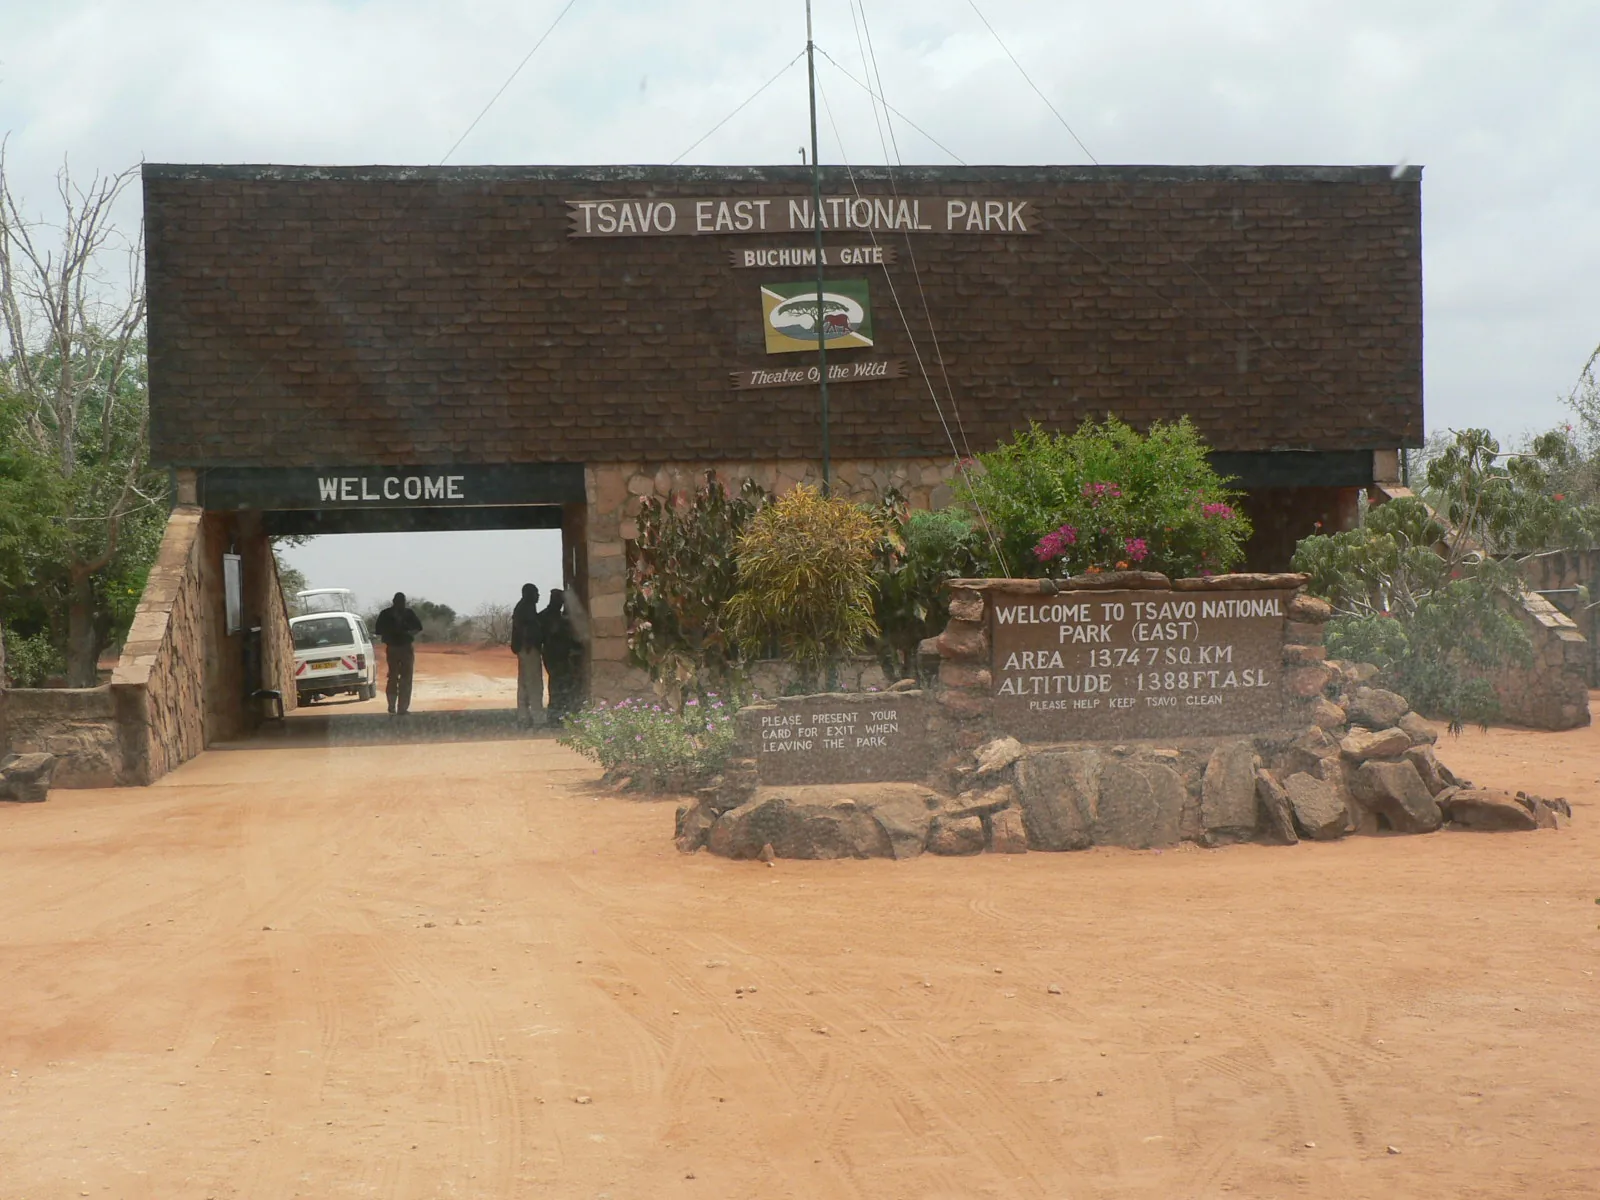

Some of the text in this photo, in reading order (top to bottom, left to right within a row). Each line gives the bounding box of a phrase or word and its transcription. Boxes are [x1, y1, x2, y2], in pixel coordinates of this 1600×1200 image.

[579, 198, 1028, 234] TSAVO EAST NATIONAL PARK
[744, 247, 883, 268] BUCHUMA GATE
[750, 369, 804, 385] Theatre
[828, 365, 849, 379] the
[853, 361, 887, 377] Wild
[318, 475, 464, 501] WELCOME
[995, 599, 1283, 625] WELCOME TO TSAVO NATIONAL
[1059, 622, 1199, 644] PARK (EAST)
[1002, 650, 1065, 671] AREA
[998, 674, 1113, 696] ALTITUDE
[1029, 695, 1223, 711] PLEASE HELP KEEP TSAVO CLEAN
[761, 710, 897, 727] PLEASE PRESENT YOUR
[762, 723, 899, 740] CARD FOR EXIT WHEN
[763, 737, 887, 753] LEAVING THE PARK
